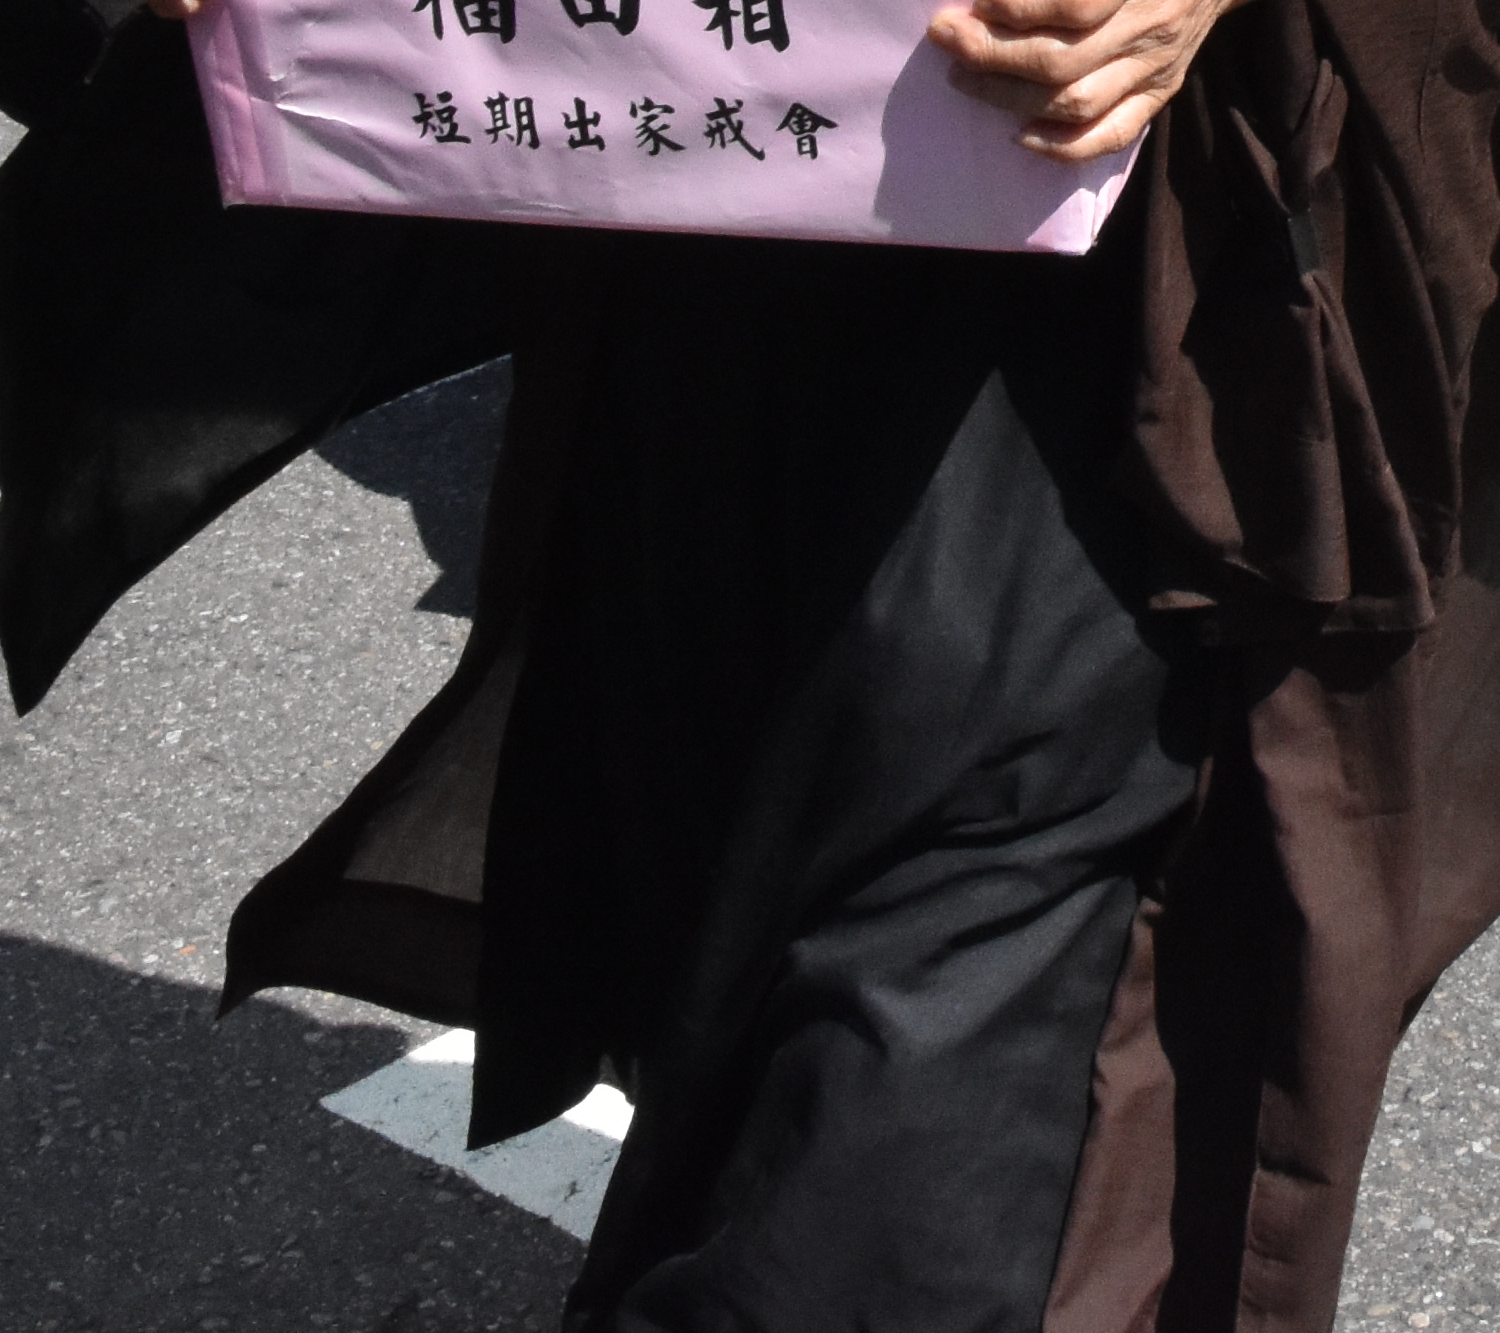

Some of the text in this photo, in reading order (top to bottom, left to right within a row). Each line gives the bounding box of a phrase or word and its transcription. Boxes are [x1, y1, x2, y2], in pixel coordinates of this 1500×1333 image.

[413, 91, 840, 161] 短期出家戒會
